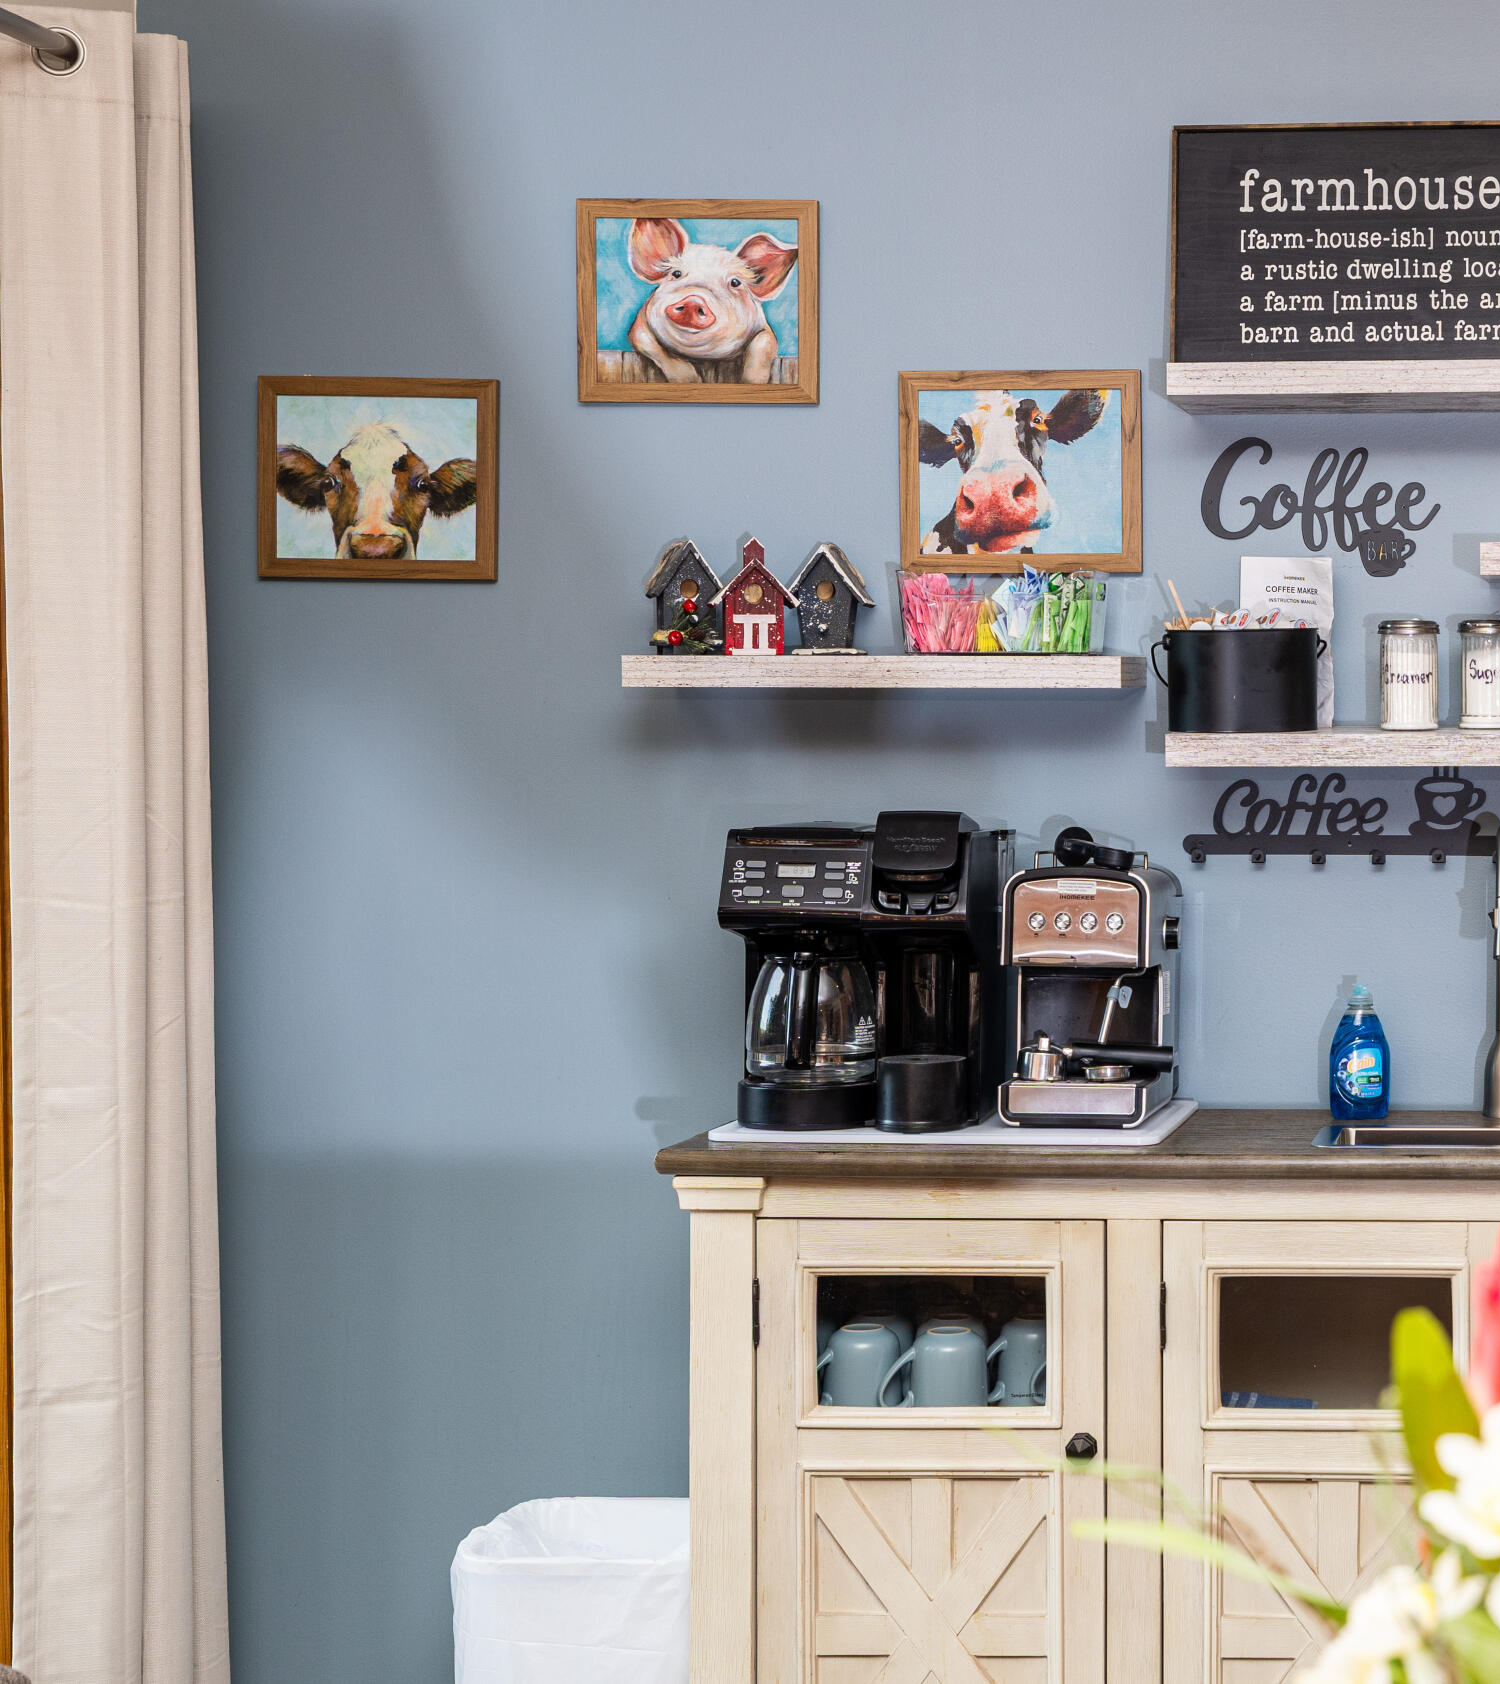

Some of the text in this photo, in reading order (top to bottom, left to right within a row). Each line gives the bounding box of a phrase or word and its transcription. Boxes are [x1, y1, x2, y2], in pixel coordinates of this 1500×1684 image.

[1240, 227, 1434, 253] [farm-house-ish]
[1240, 264, 1255, 281] a
[1264, 259, 1338, 281] rustic
[1346, 258, 1453, 284] dwelling
[1239, 295, 1255, 313] a
[1263, 290, 1325, 312] farm
[1333, 290, 1418, 314] [minus
[1428, 288, 1469, 310] the
[1239, 322, 1300, 344] barn
[1309, 321, 1355, 343] and
[1364, 320, 1445, 343] actual
[1201, 436, 1440, 552] Coffee
[1367, 539, 1399, 561] BAR
[1265, 585, 1319, 595] COFFEE MAKER
[1213, 773, 1388, 836] Coffee
